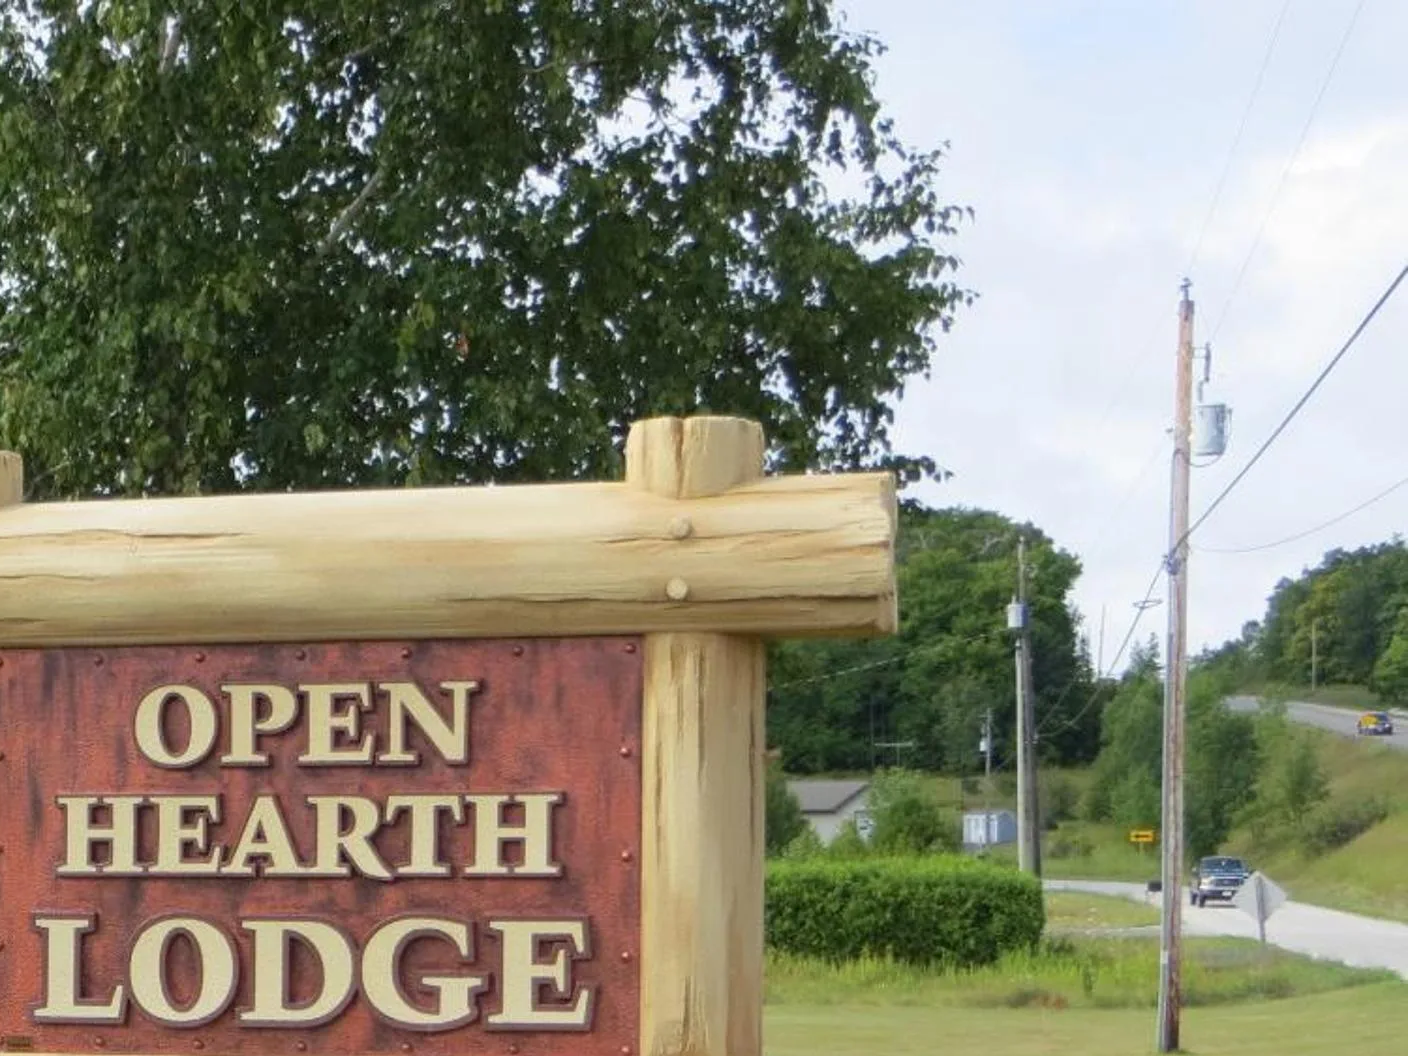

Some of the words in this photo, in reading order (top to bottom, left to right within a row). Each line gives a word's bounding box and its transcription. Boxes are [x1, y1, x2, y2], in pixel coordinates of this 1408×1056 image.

[134, 679, 478, 768] OPEN
[56, 793, 565, 881] HEARTH
[32, 917, 591, 1028] LODGE
